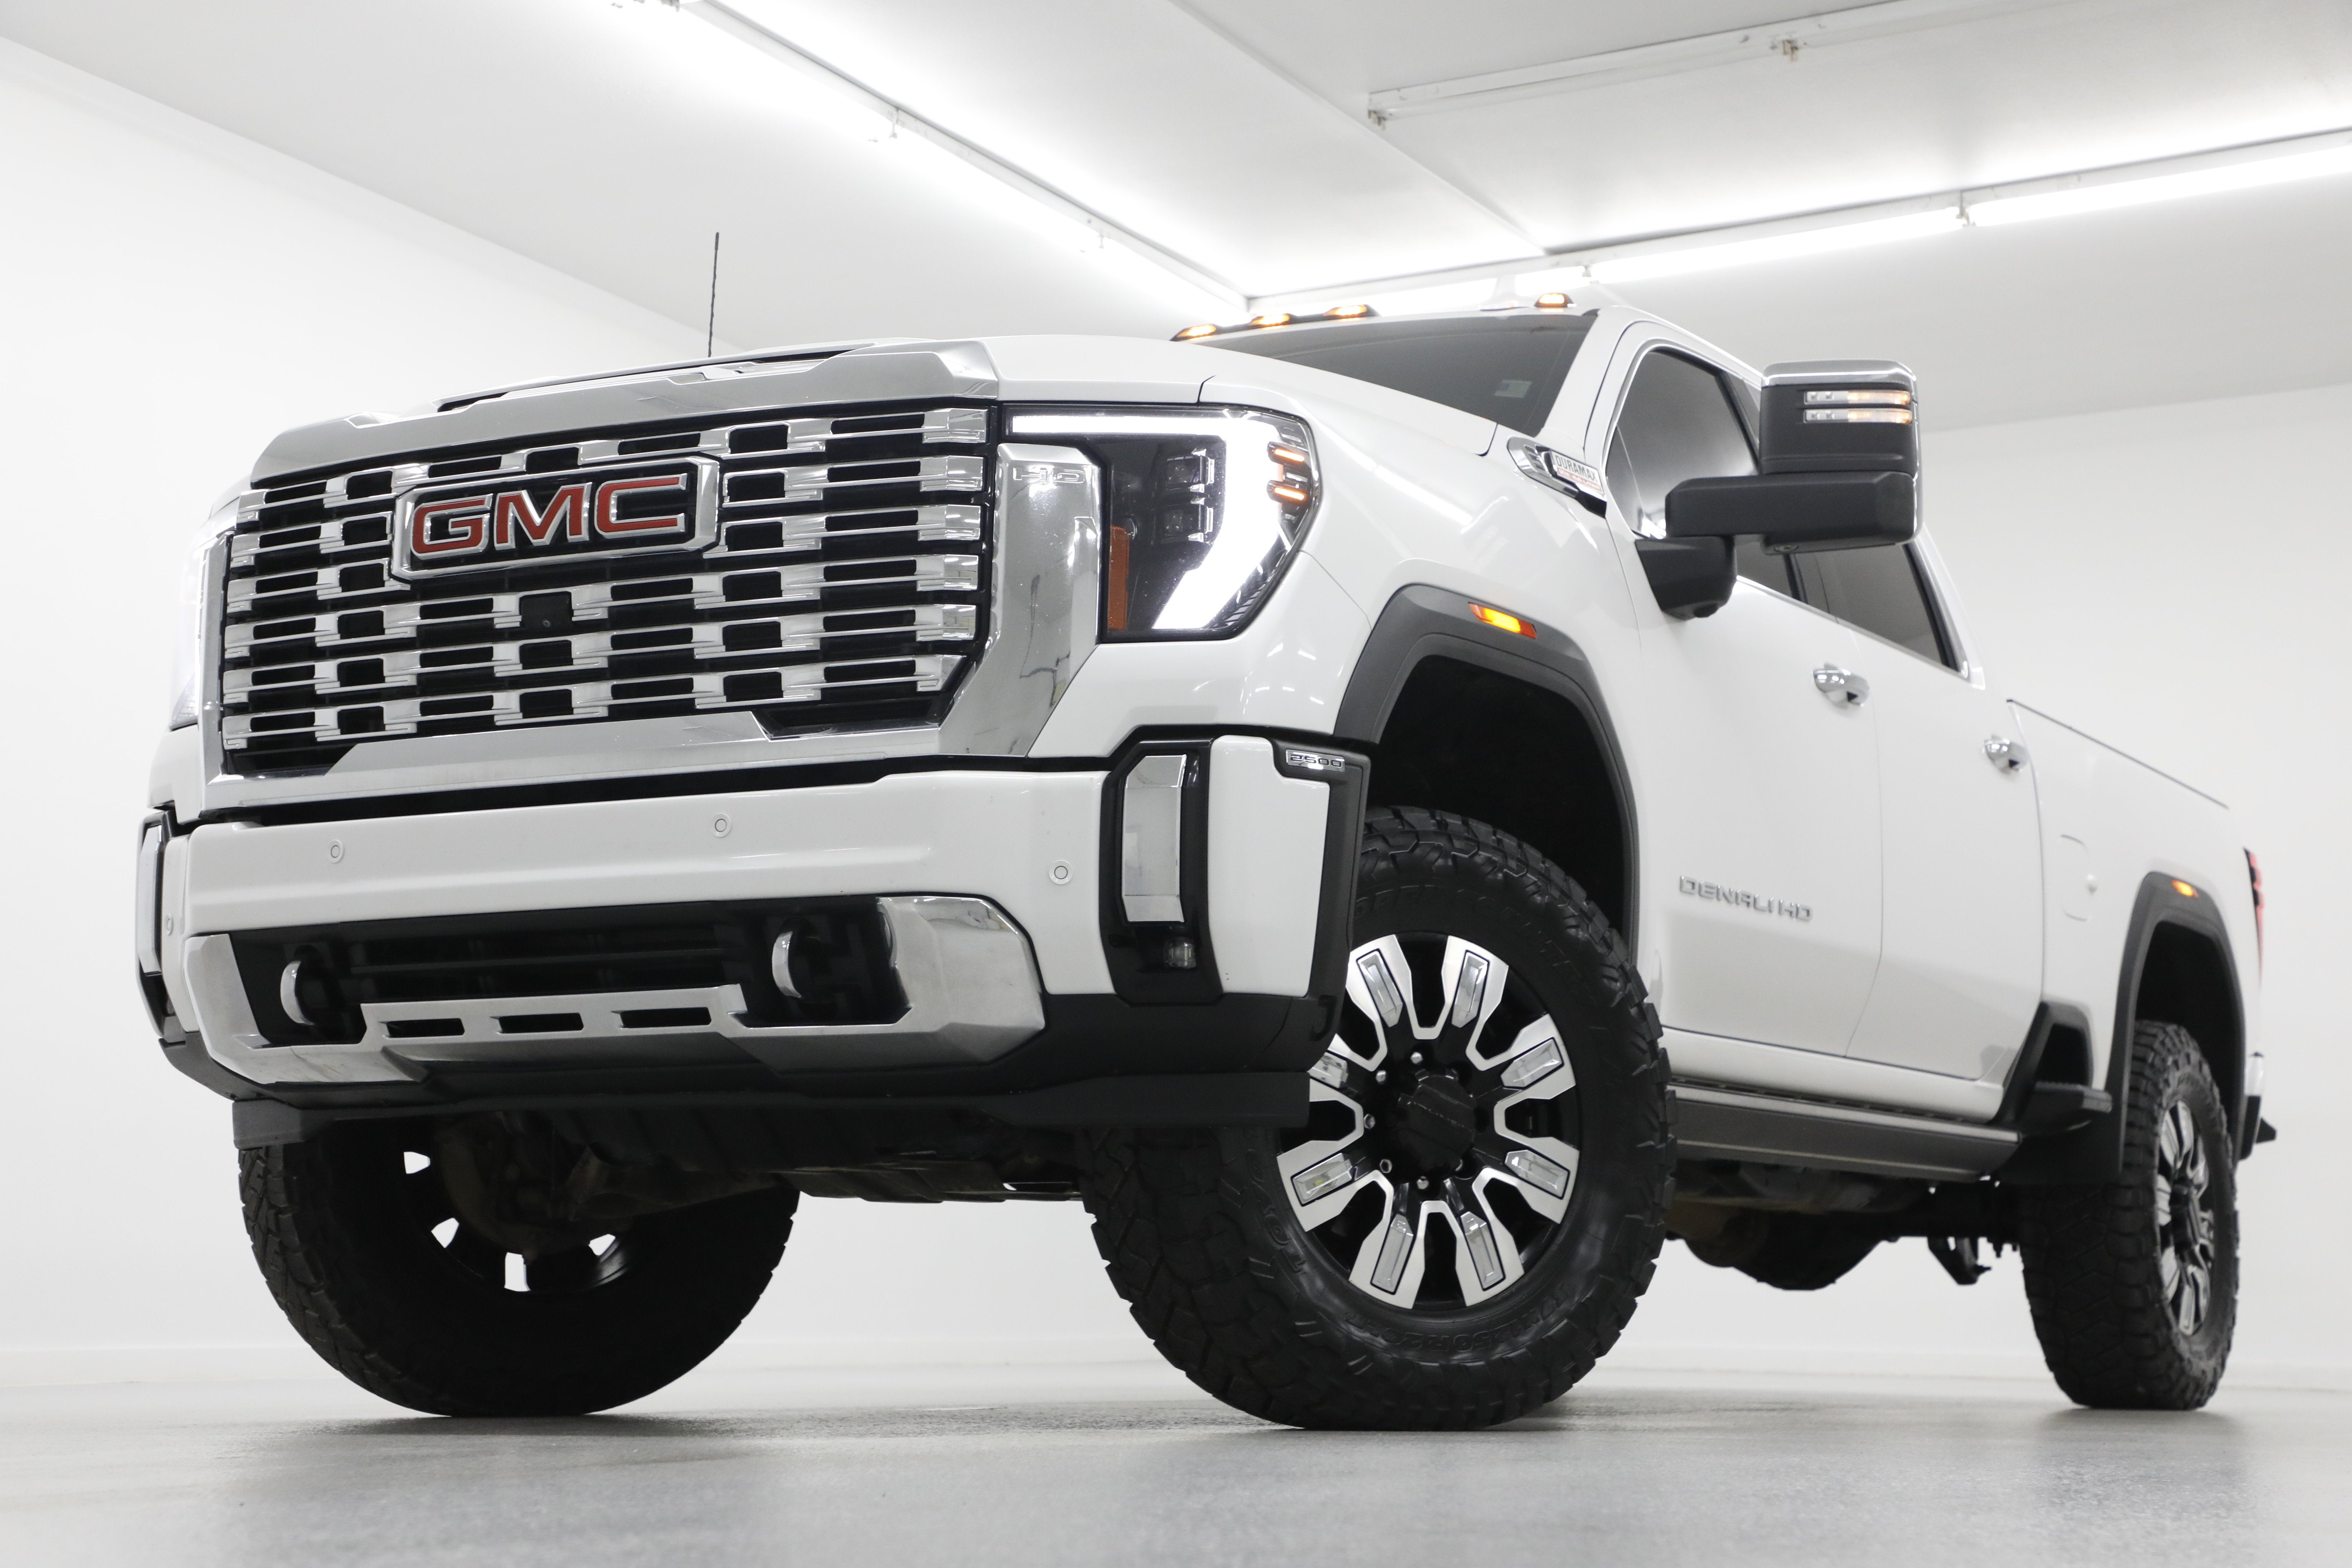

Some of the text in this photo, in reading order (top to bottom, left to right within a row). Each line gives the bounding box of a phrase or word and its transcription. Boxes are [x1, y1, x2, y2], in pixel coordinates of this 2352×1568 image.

[1555, 455, 1598, 483] DURAMAX
[410, 473, 687, 560] GMC
[1290, 754, 1342, 767] 2500
[1680, 875, 1813, 922] DENALI HD
